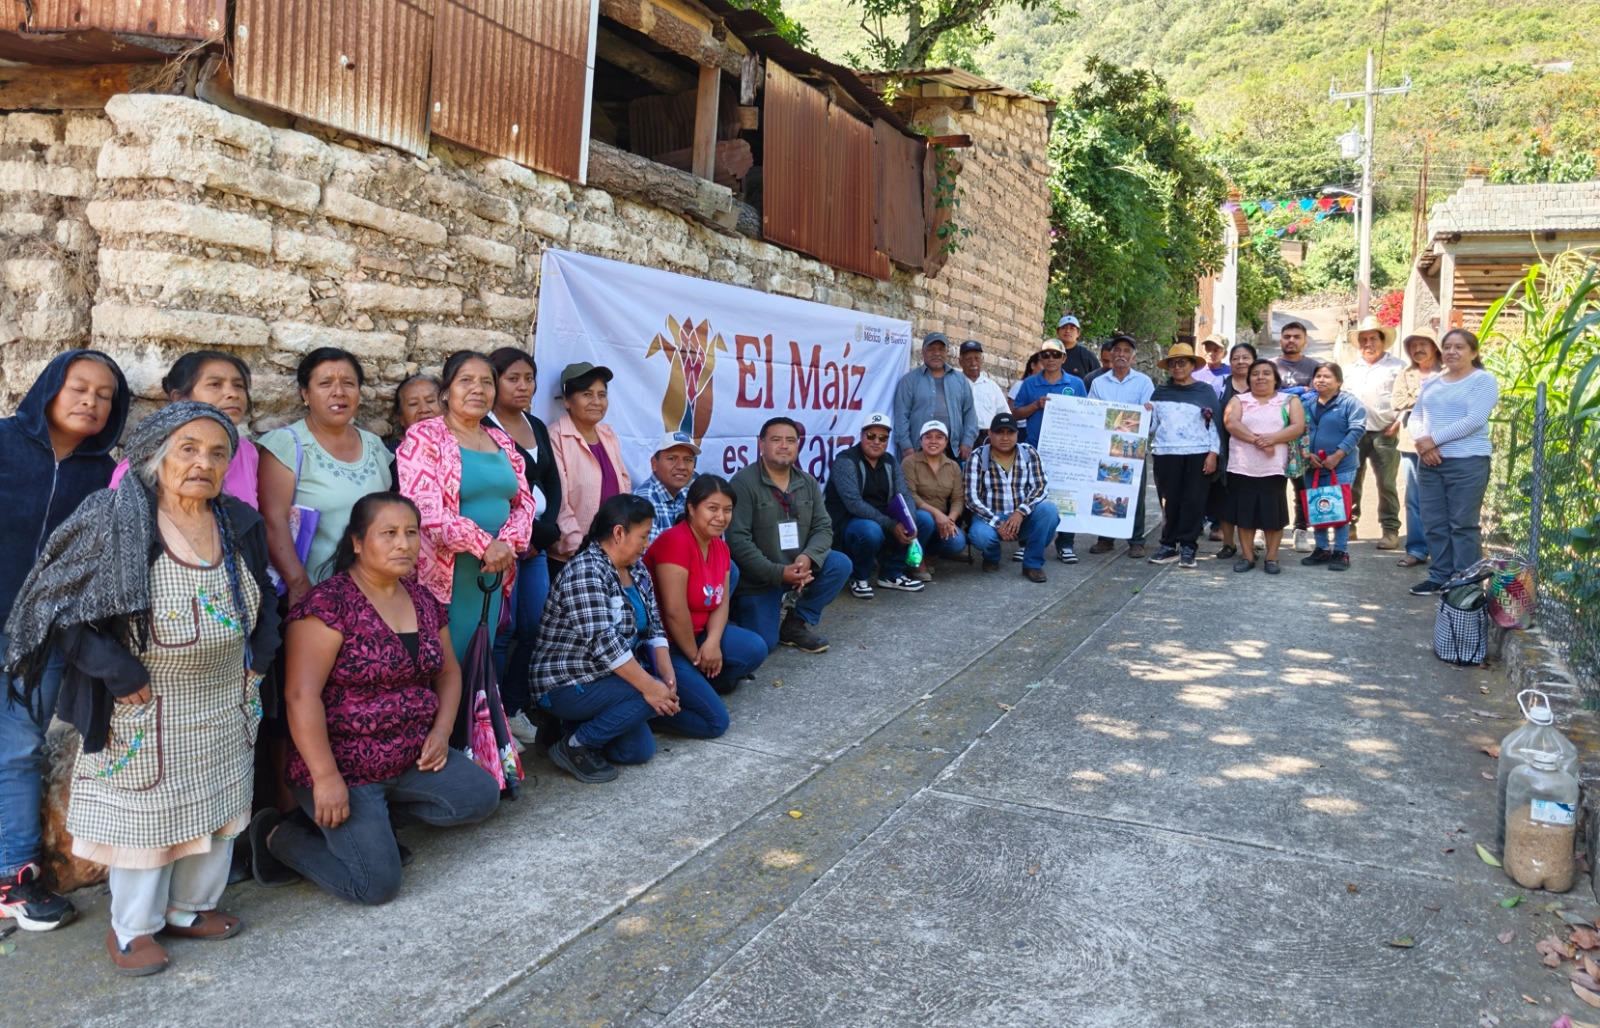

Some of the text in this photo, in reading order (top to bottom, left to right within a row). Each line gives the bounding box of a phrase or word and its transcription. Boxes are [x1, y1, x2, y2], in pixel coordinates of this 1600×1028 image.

[864, 331, 881, 343] México
[735, 334, 866, 411] El Maíz
[723, 445, 748, 474] es
